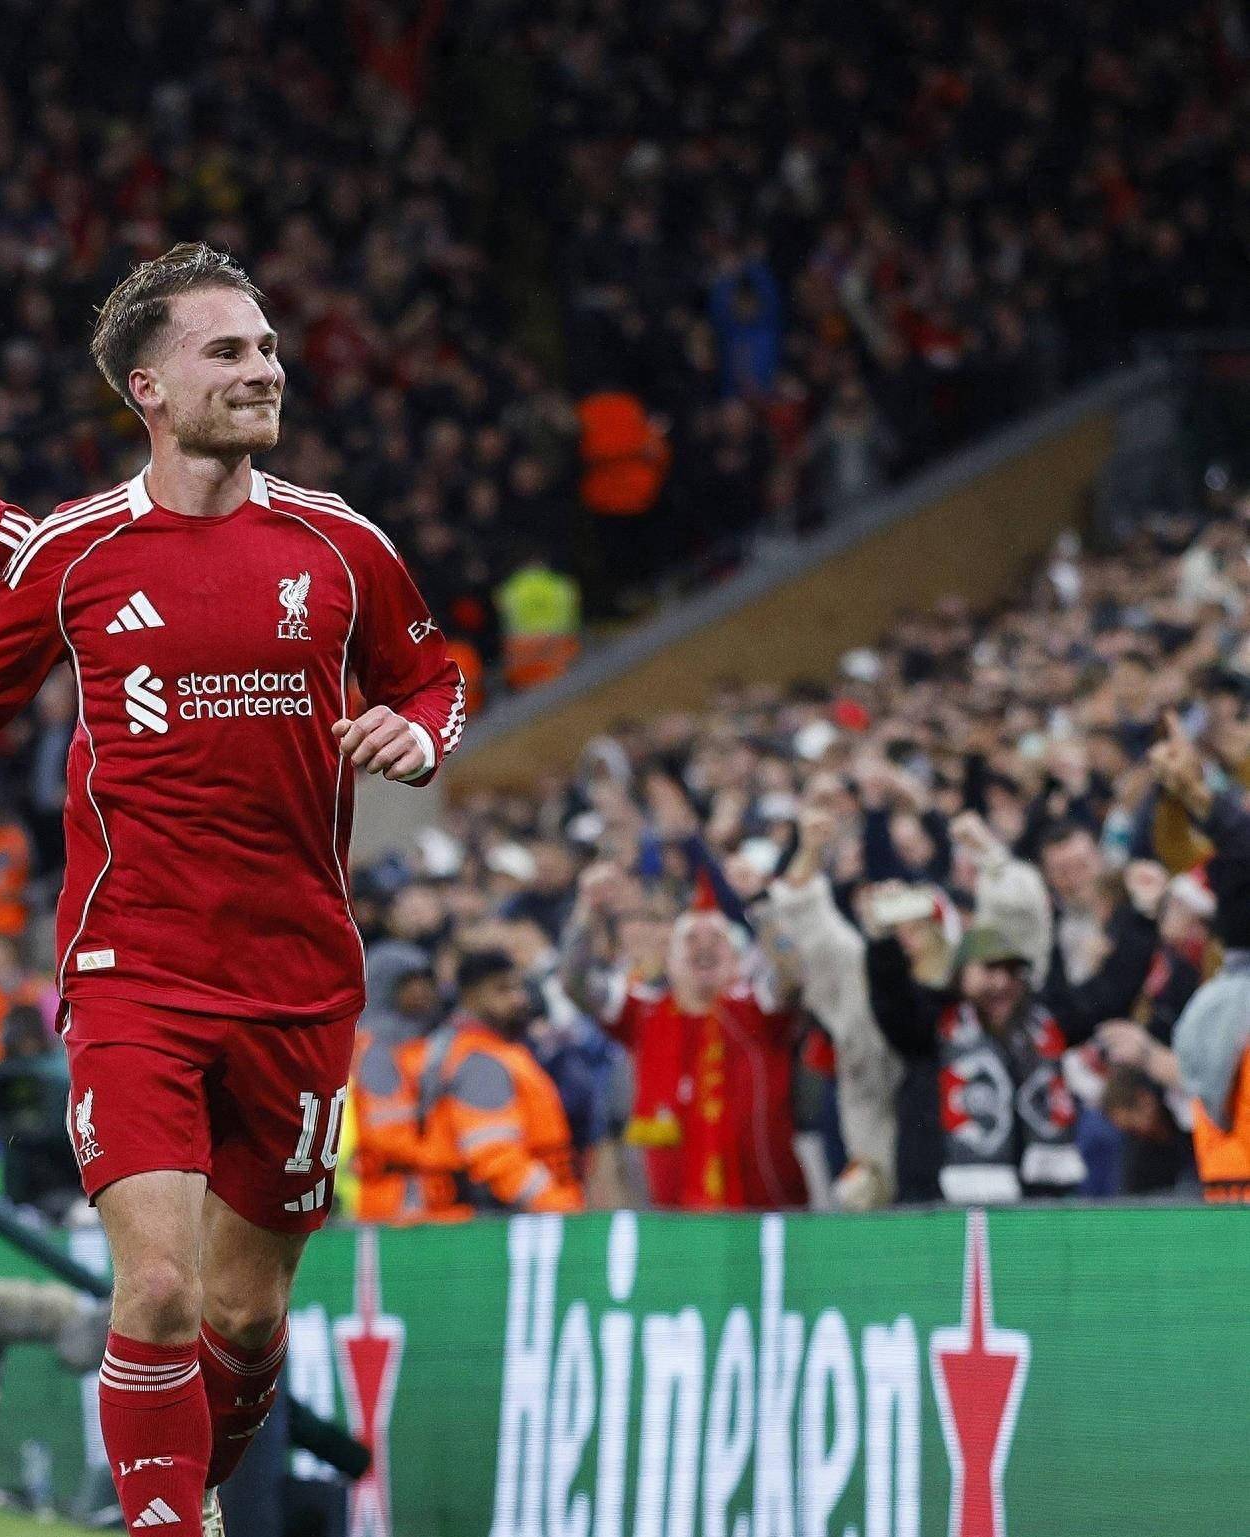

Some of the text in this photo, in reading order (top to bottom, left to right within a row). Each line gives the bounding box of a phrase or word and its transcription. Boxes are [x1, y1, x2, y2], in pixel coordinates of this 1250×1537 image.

[177, 668, 306, 696] standard
[179, 693, 313, 720] chartered
[488, 1210, 922, 1537] Heineken
[119, 1456, 174, 1477] LFC
